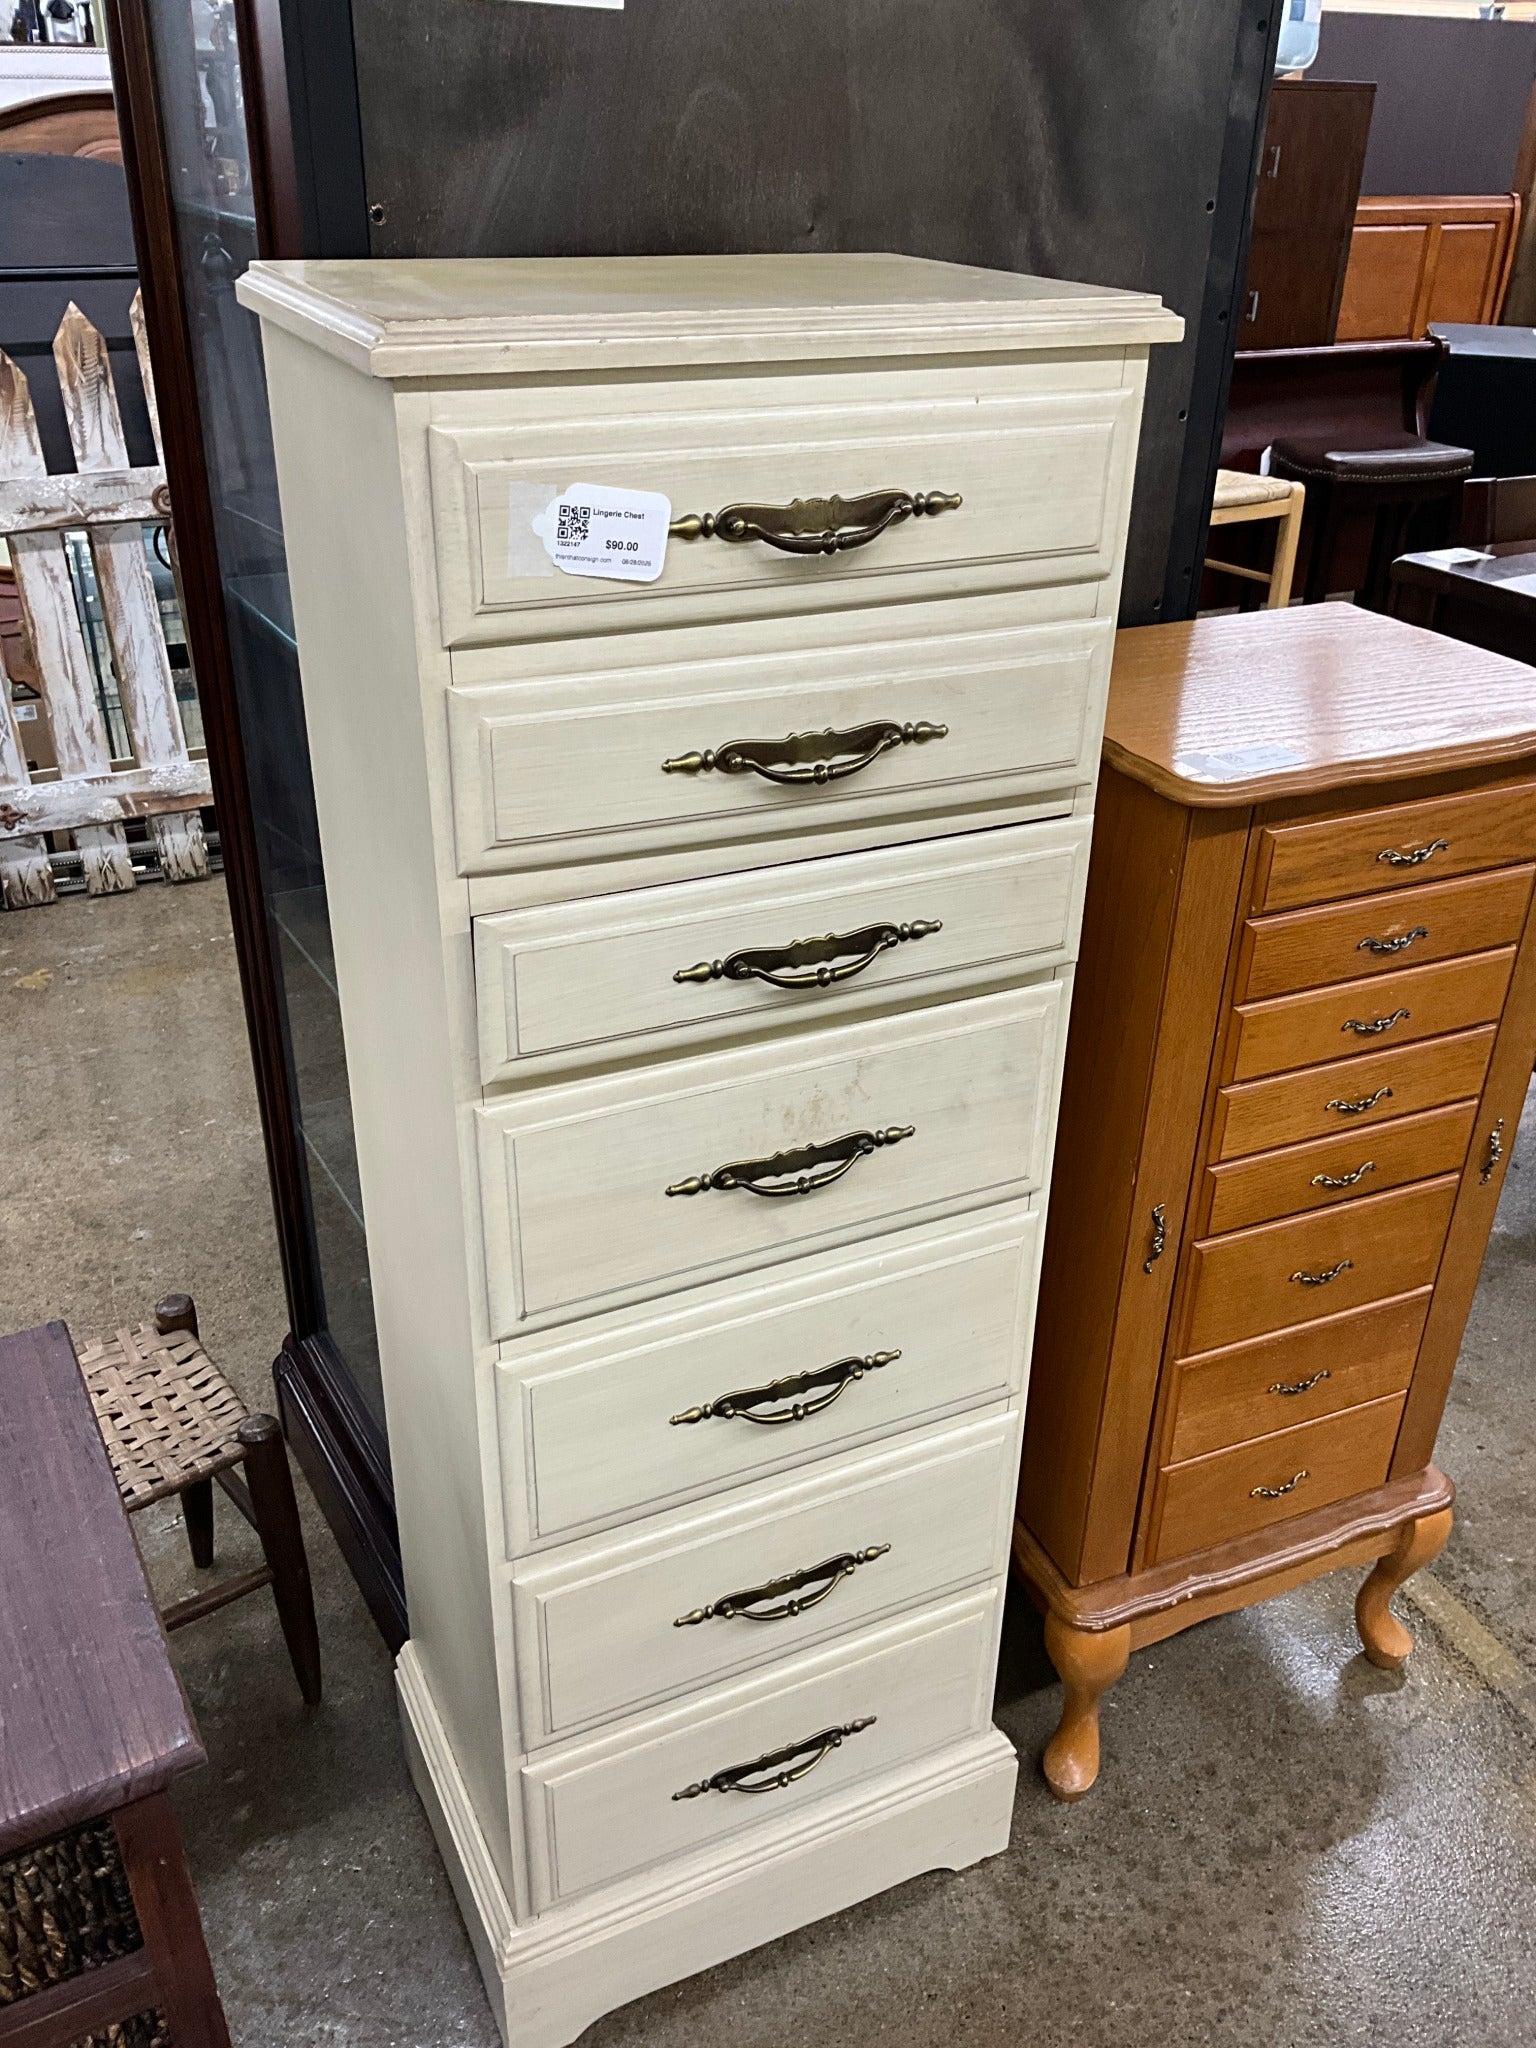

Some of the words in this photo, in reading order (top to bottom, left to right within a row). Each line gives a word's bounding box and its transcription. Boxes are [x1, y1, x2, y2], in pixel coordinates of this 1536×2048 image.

[593, 509, 622, 518] Lingerie
[624, 511, 645, 520] Chest
[605, 540, 639, 551] $90.00
